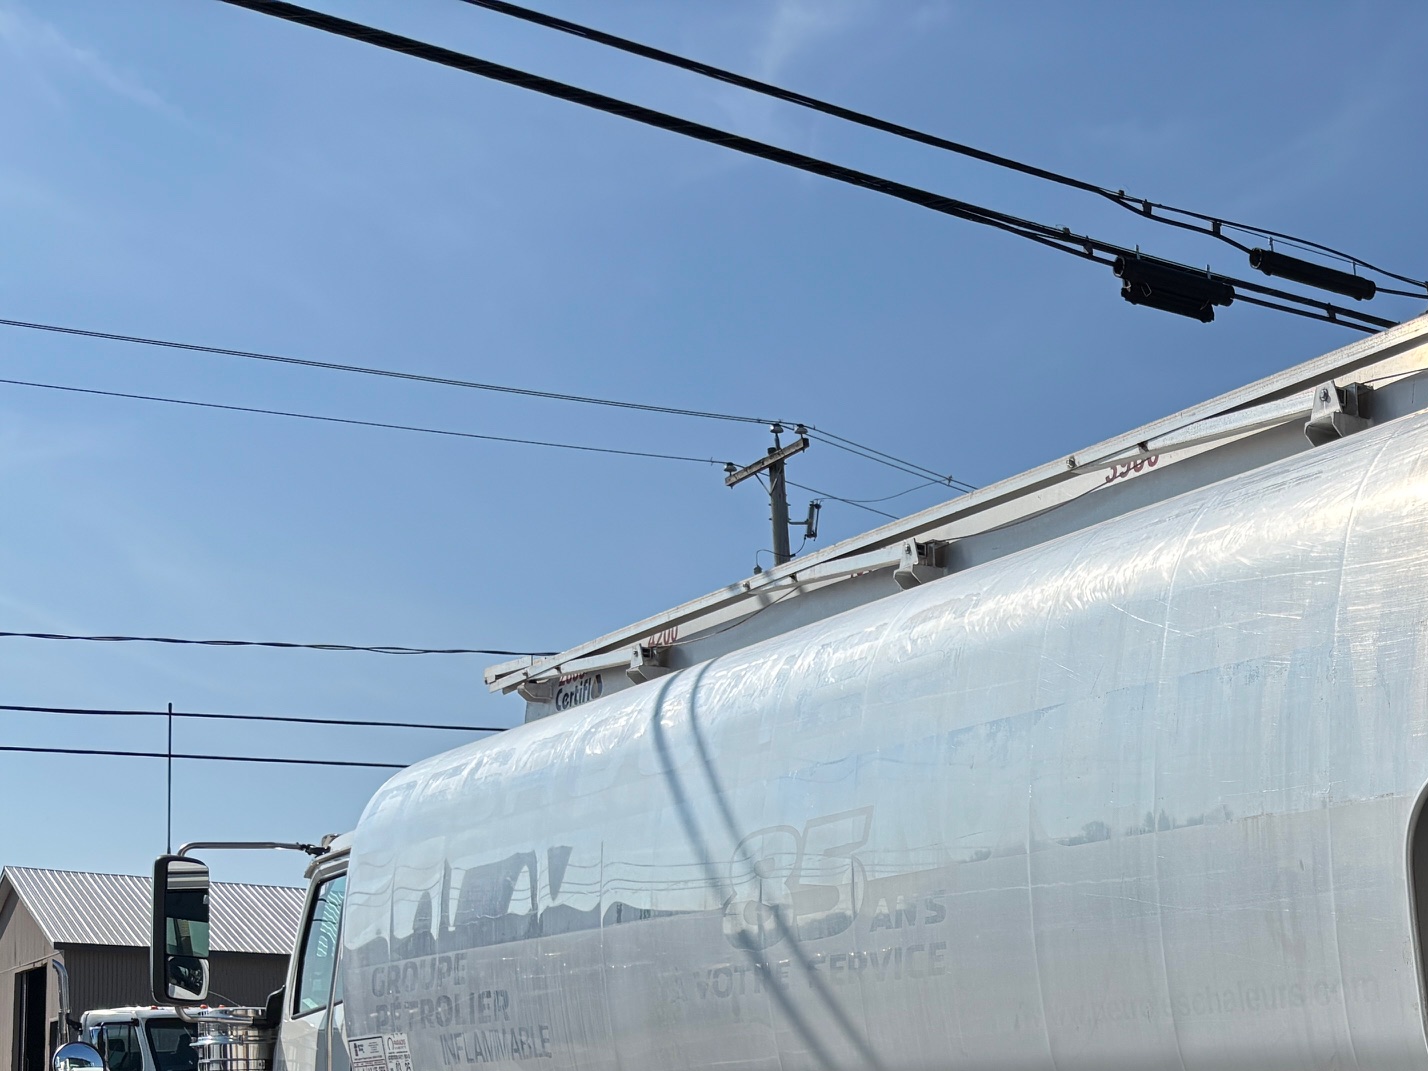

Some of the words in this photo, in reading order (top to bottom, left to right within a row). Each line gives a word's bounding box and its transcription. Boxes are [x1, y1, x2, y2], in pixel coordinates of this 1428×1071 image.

[869, 889, 947, 933] ANS
[371, 952, 468, 998] GROUPE
[374, 988, 511, 1036] PÉTROLIER
